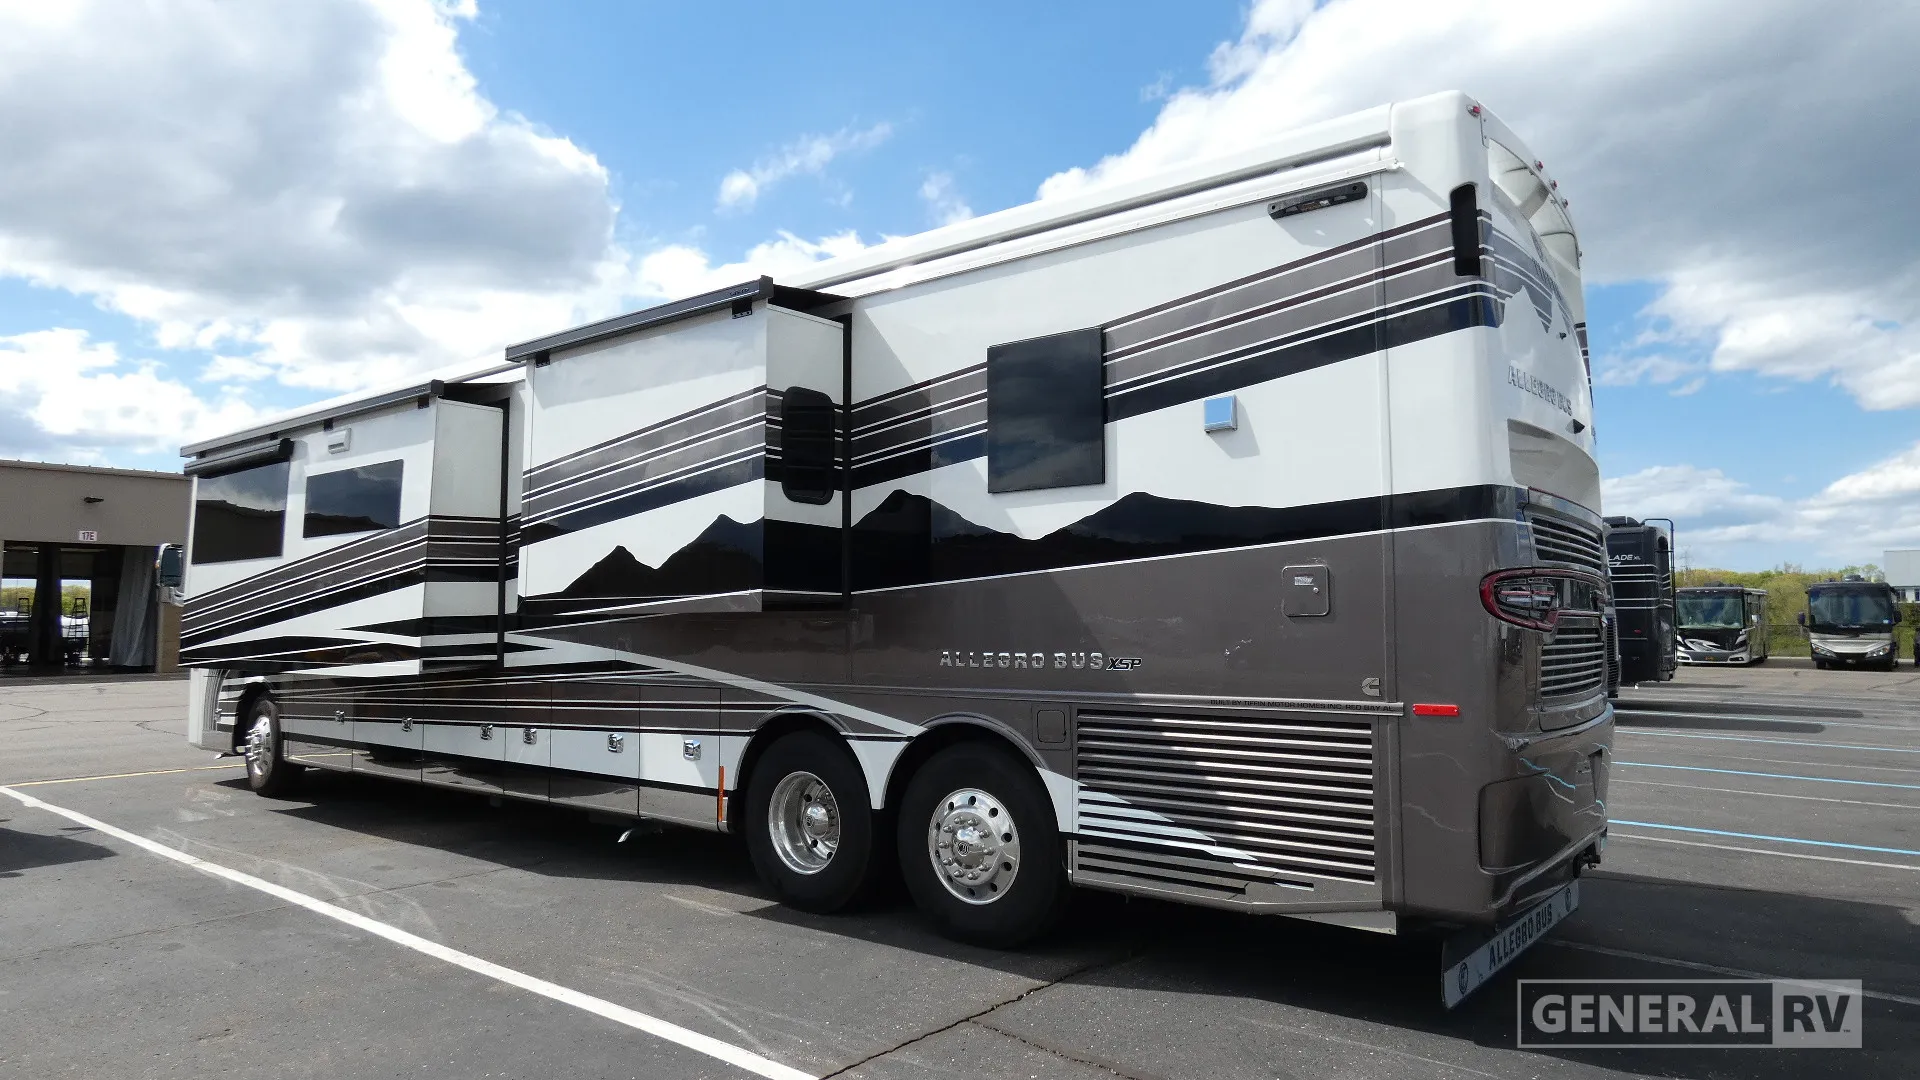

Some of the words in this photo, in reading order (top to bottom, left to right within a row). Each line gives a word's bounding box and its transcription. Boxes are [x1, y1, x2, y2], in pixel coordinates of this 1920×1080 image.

[1508, 365, 1556, 406] ALLEGRO
[81, 531, 95, 541] 17E
[939, 651, 1045, 668] ALLEGRO
[1053, 652, 1103, 669] BUS
[1106, 656, 1142, 671] XSP
[1244, 700, 1266, 708] TIFFIN
[1267, 701, 1296, 709] MOTOR
[1364, 704, 1381, 712] BAY
[1489, 918, 1534, 971] ALLEGRO
[1536, 903, 1553, 933] BUS
